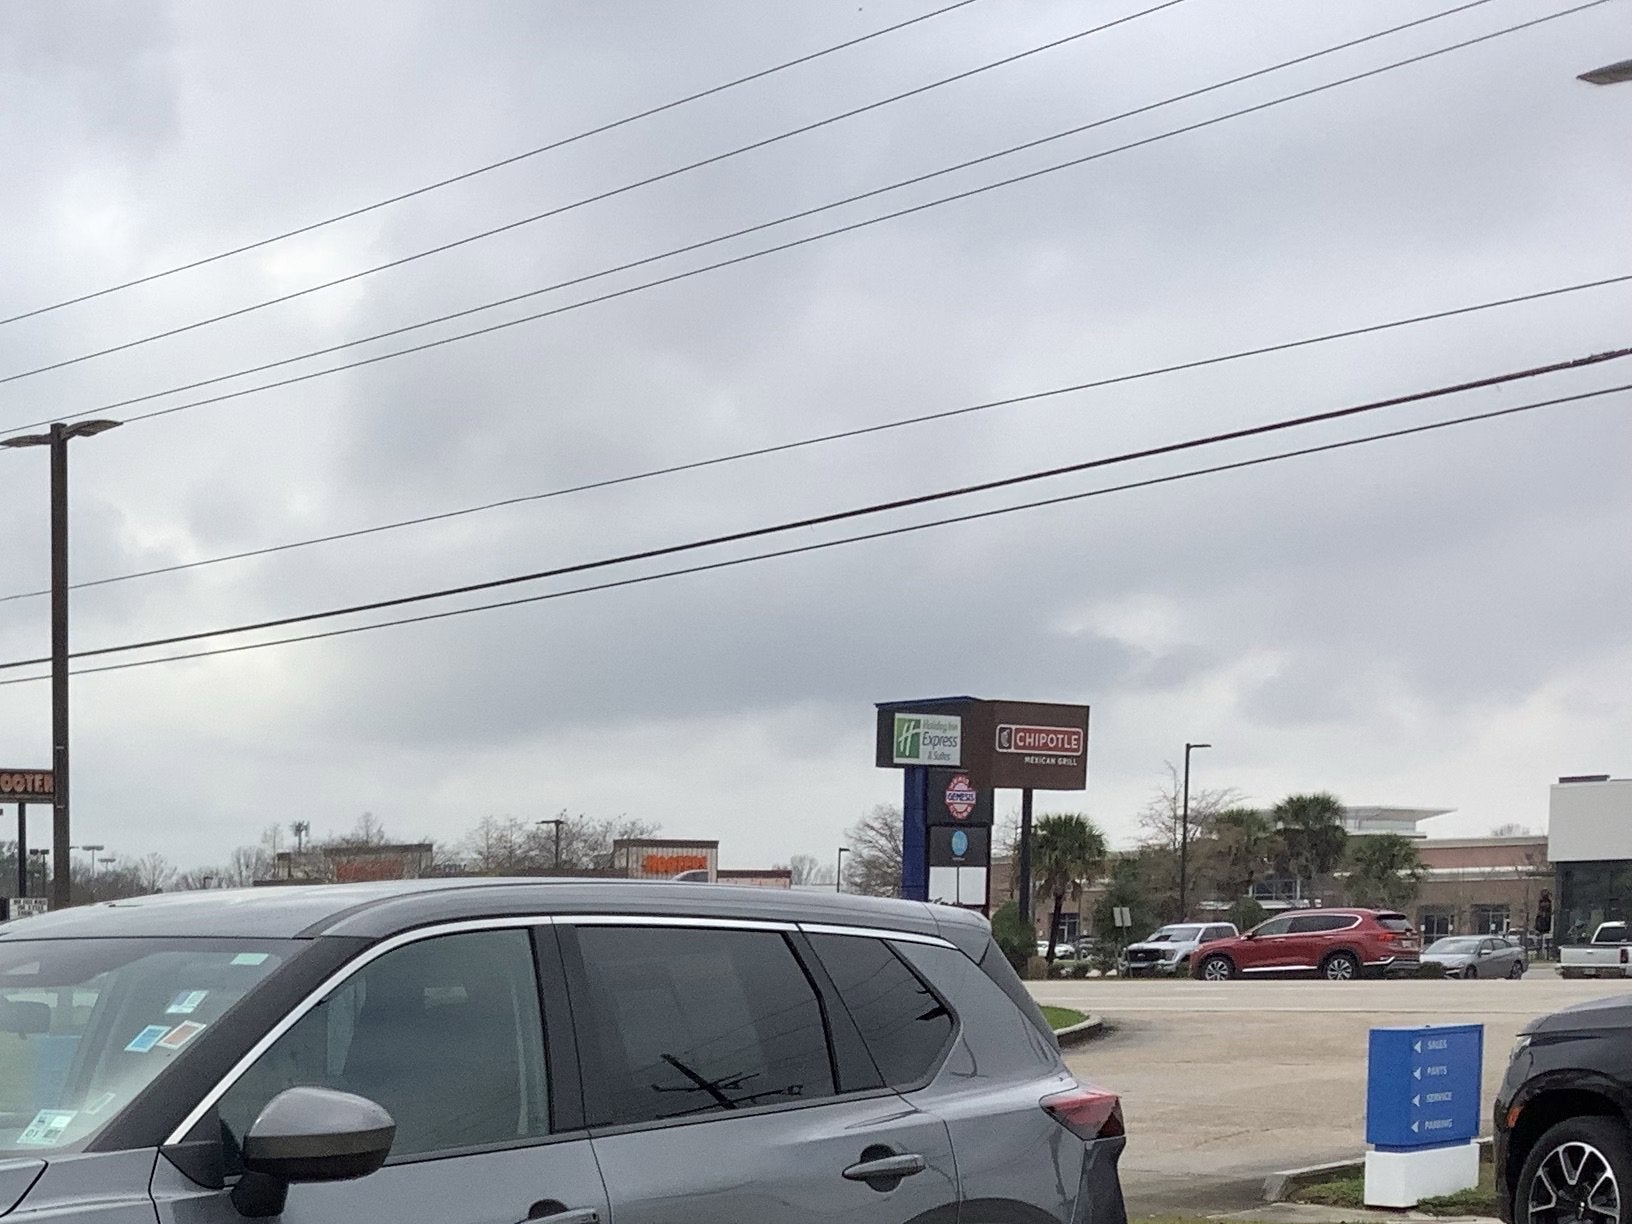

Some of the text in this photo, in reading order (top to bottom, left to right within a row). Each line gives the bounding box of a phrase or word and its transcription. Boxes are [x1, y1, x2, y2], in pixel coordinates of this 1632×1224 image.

[922, 731, 958, 750] Express
[1016, 732, 1079, 749] CHIPOTLE
[1024, 755, 1078, 766] MEXICAN GRILL
